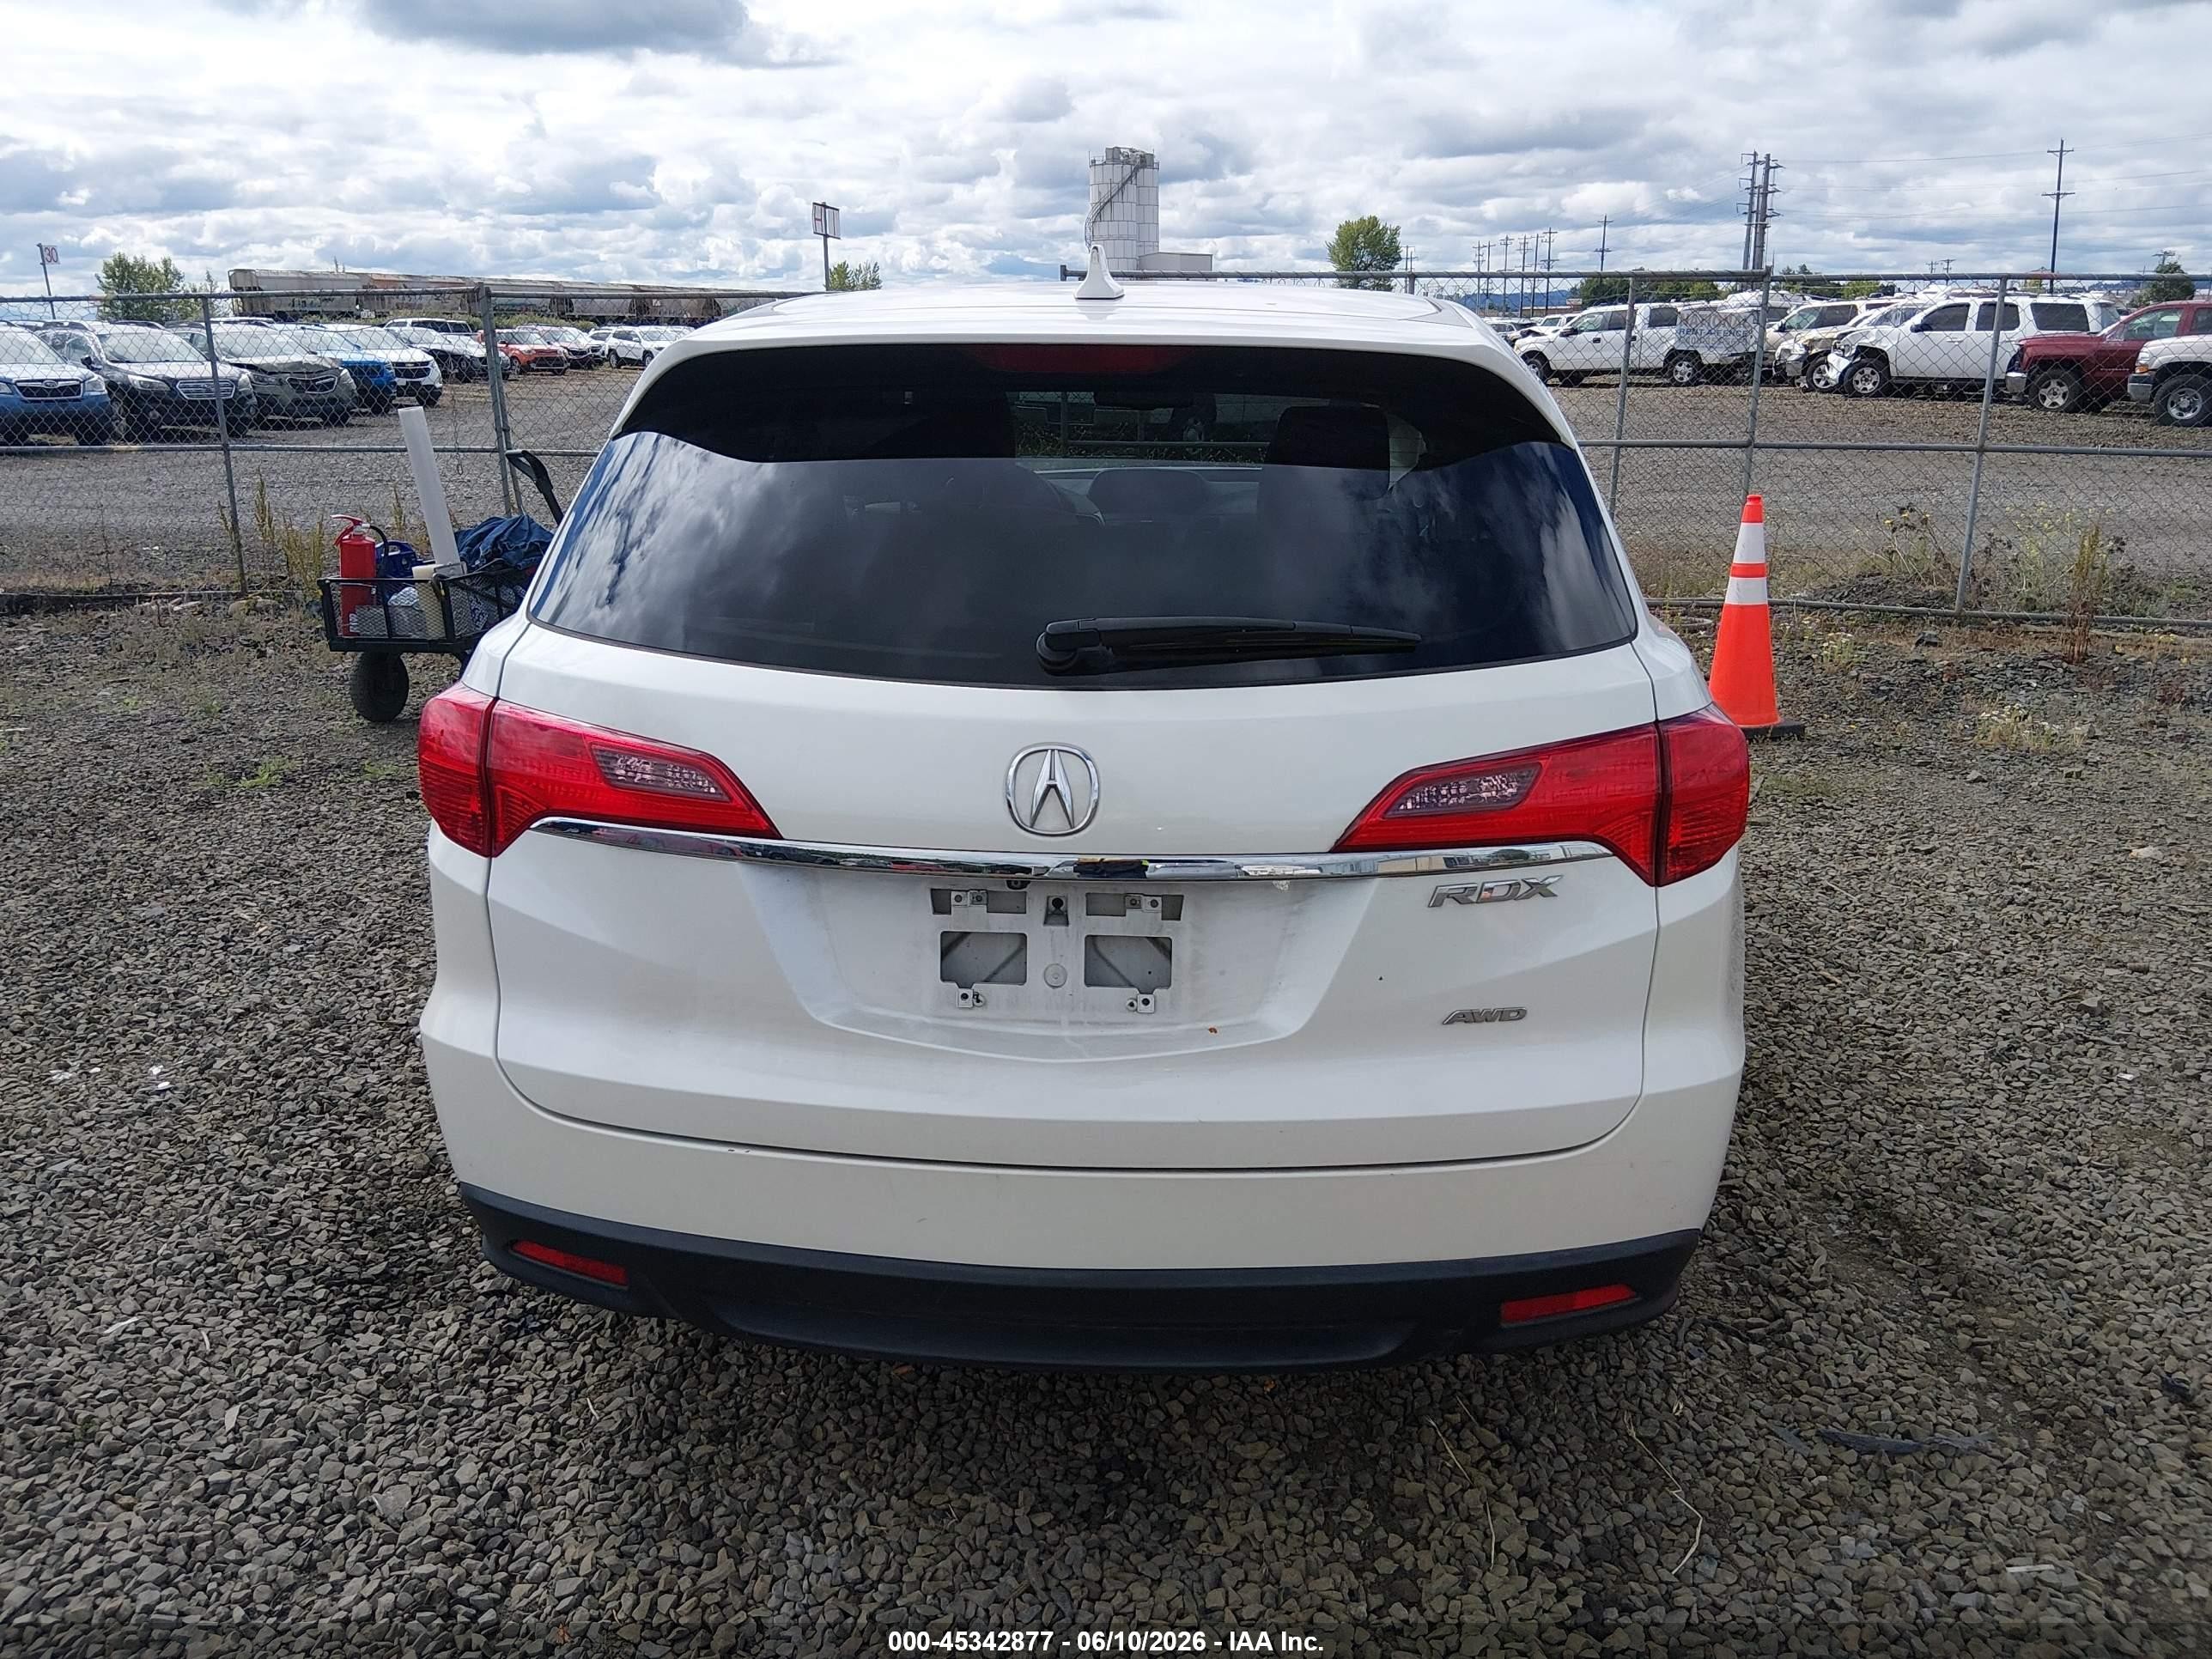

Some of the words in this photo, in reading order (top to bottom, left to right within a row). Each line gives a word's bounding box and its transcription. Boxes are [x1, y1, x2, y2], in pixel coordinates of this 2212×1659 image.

[44, 246, 58, 263] 30
[1679, 327, 1749, 337] RENT-A-FENCE
[1428, 874, 1564, 908] RDX
[1442, 1007, 1528, 1025] AWD
